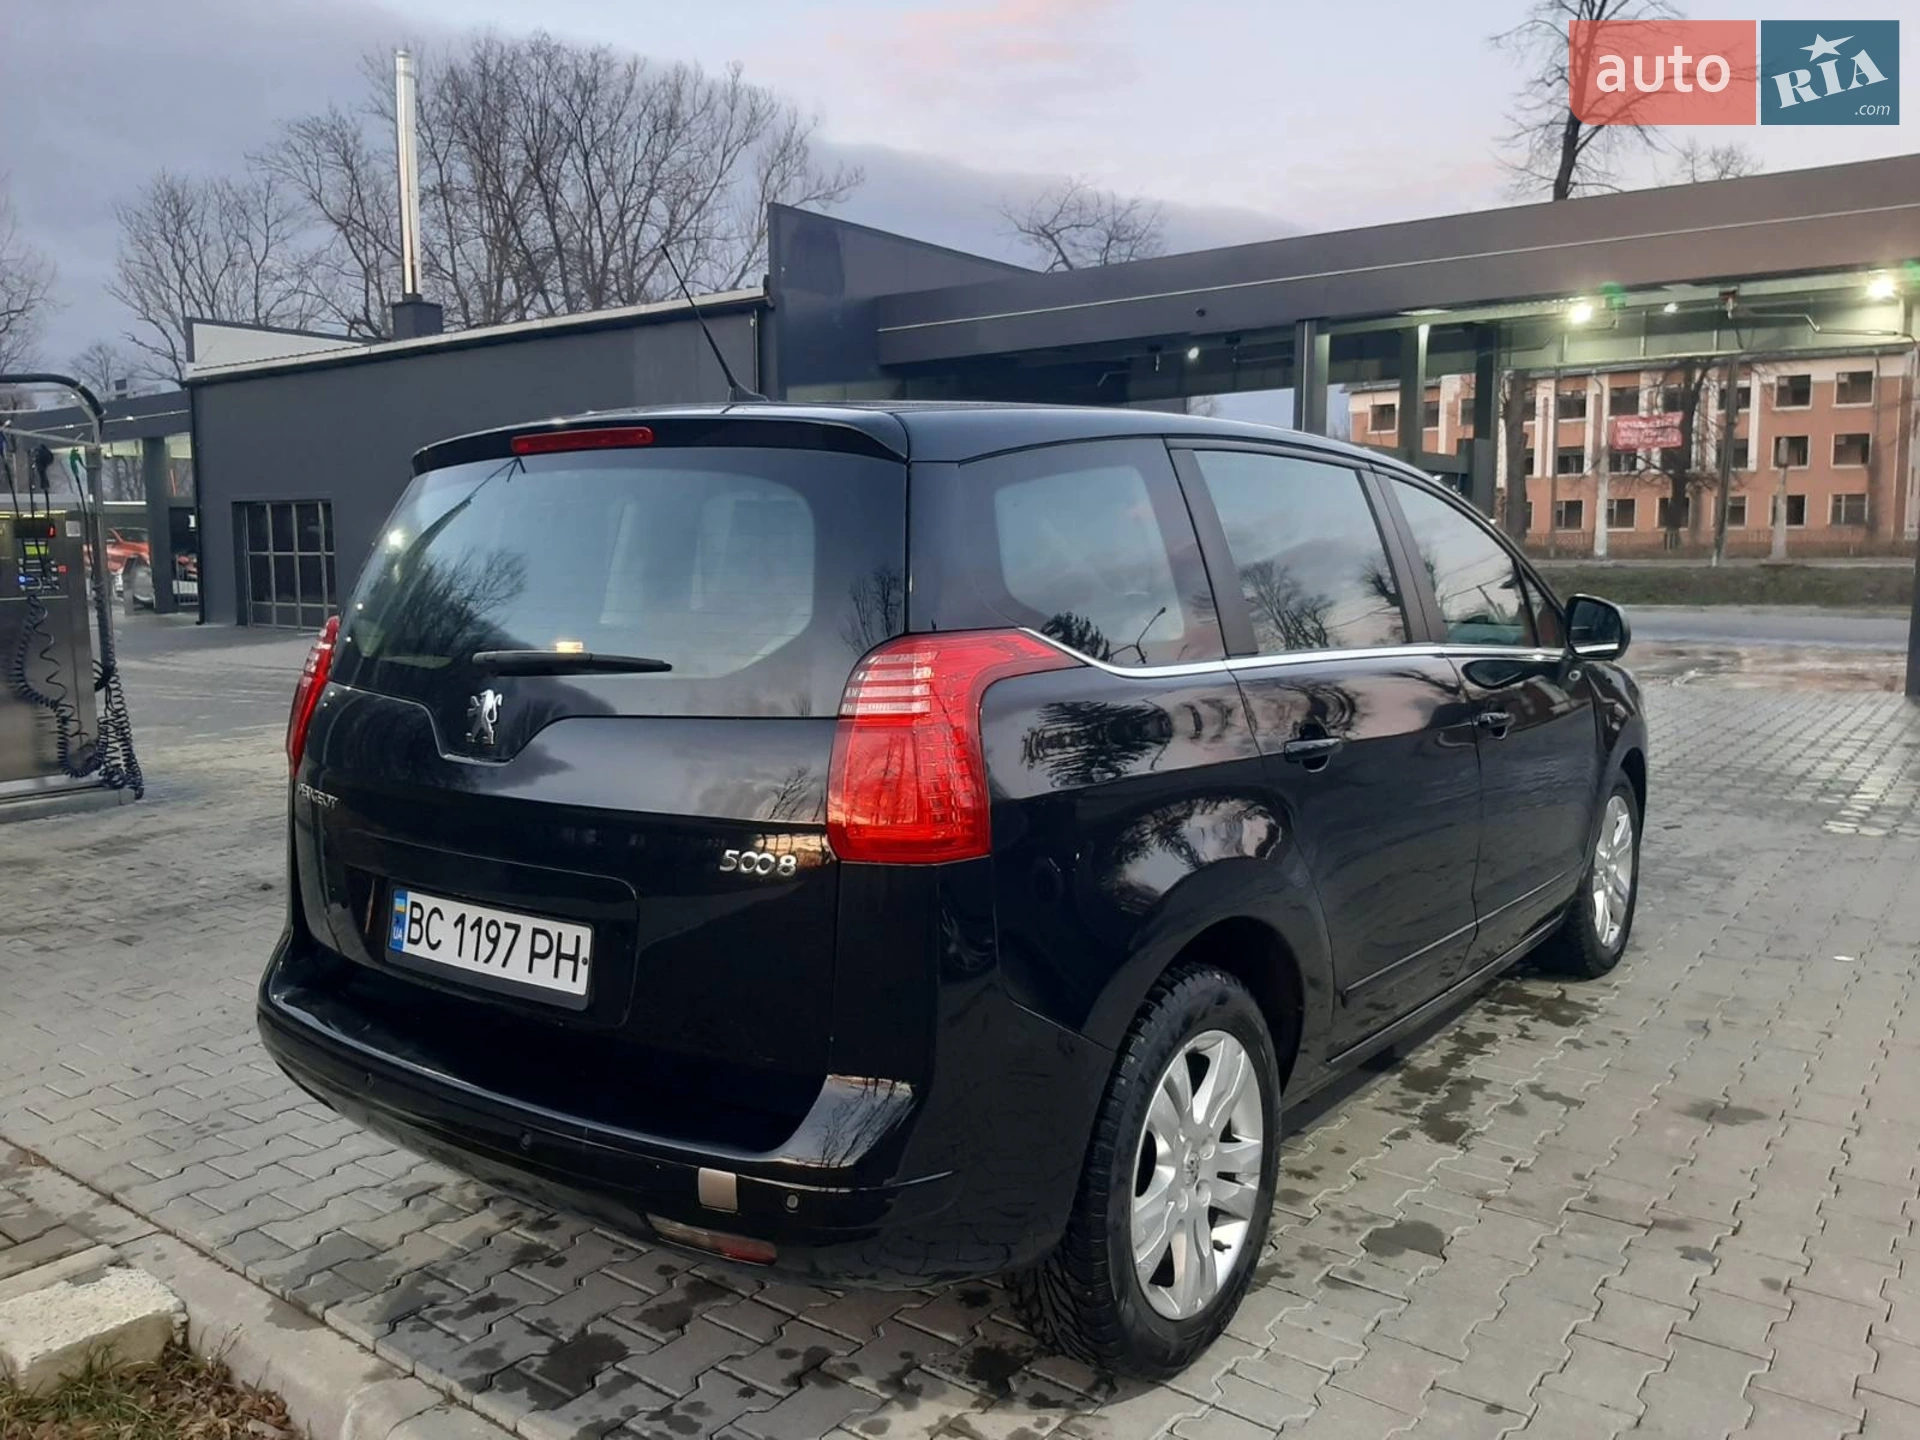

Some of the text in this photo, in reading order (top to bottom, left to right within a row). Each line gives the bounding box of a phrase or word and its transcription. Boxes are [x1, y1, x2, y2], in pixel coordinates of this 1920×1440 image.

[720, 849, 797, 876] 5008
[407, 901, 581, 983] BC 1197 PH
